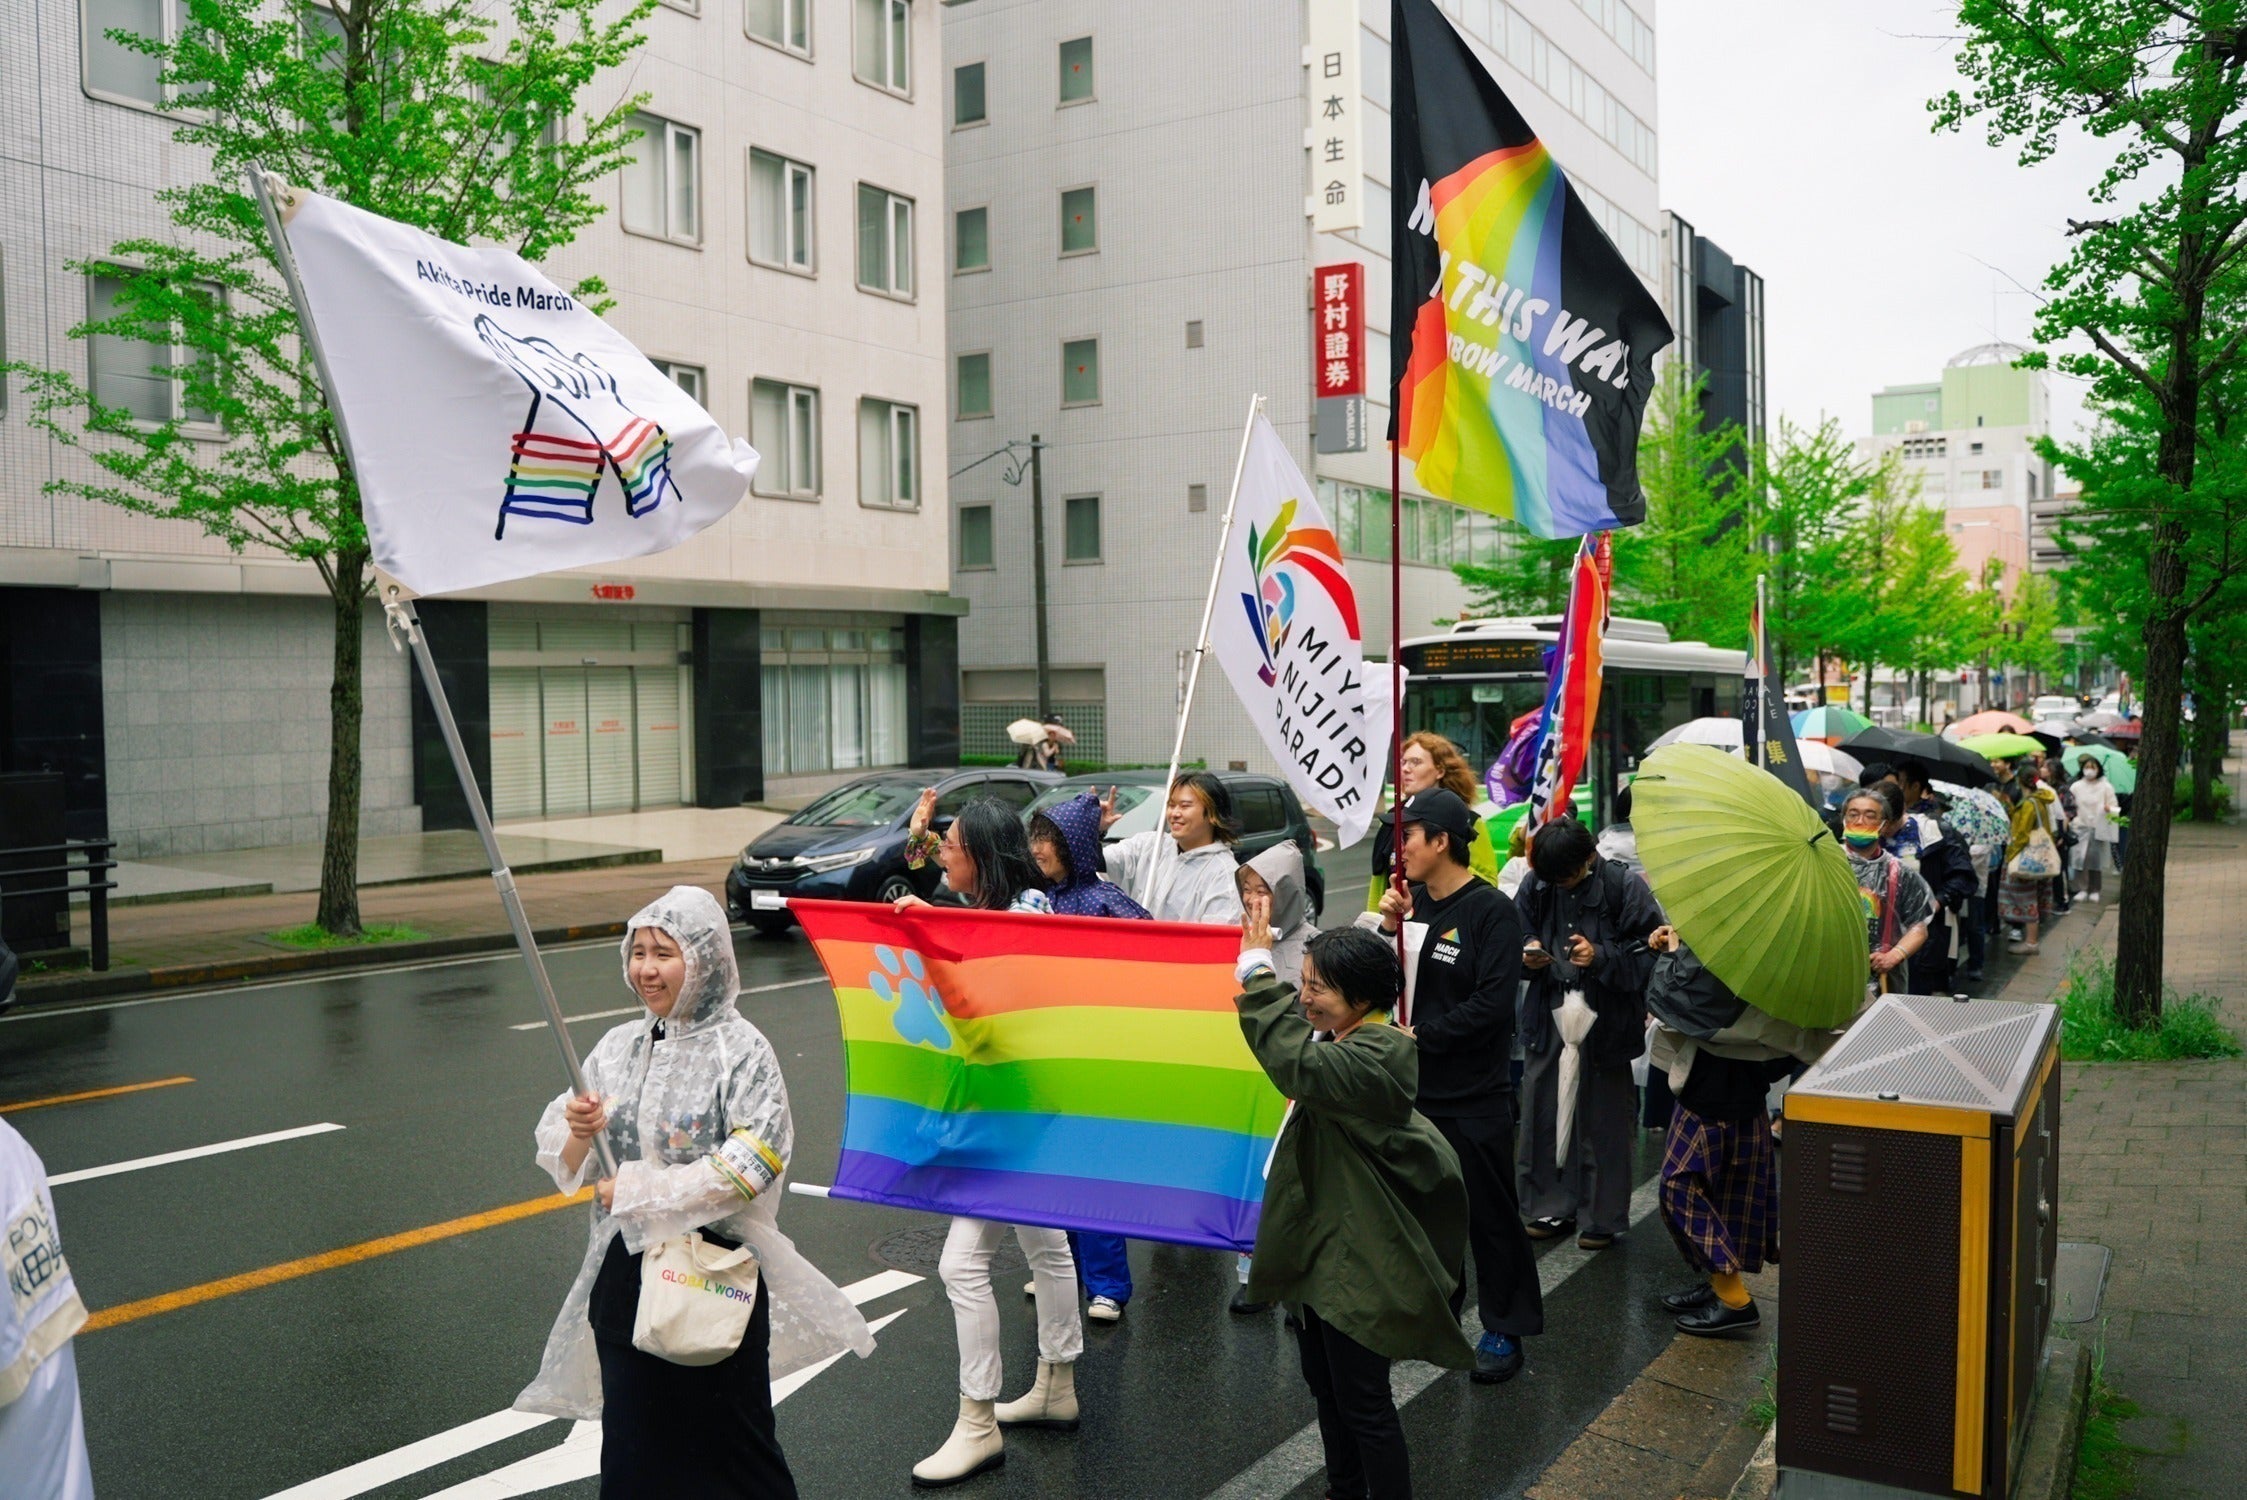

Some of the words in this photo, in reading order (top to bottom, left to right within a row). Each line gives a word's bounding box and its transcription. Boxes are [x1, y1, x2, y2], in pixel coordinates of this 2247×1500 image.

[1322, 52, 1346, 206] 日本生命
[417, 259, 463, 295] Akita
[462, 279, 512, 307] Pride
[517, 286, 573, 311] March
[1450, 260, 1550, 342] THIS
[1323, 272, 1350, 388] 野村證券
[1504, 363, 1592, 419] MARCH
[1282, 660, 1368, 780] NIJIIR
[1434, 942, 1461, 957] MARCH
[661, 1269, 712, 1293] GLOBAL
[715, 1284, 753, 1305] WORK
